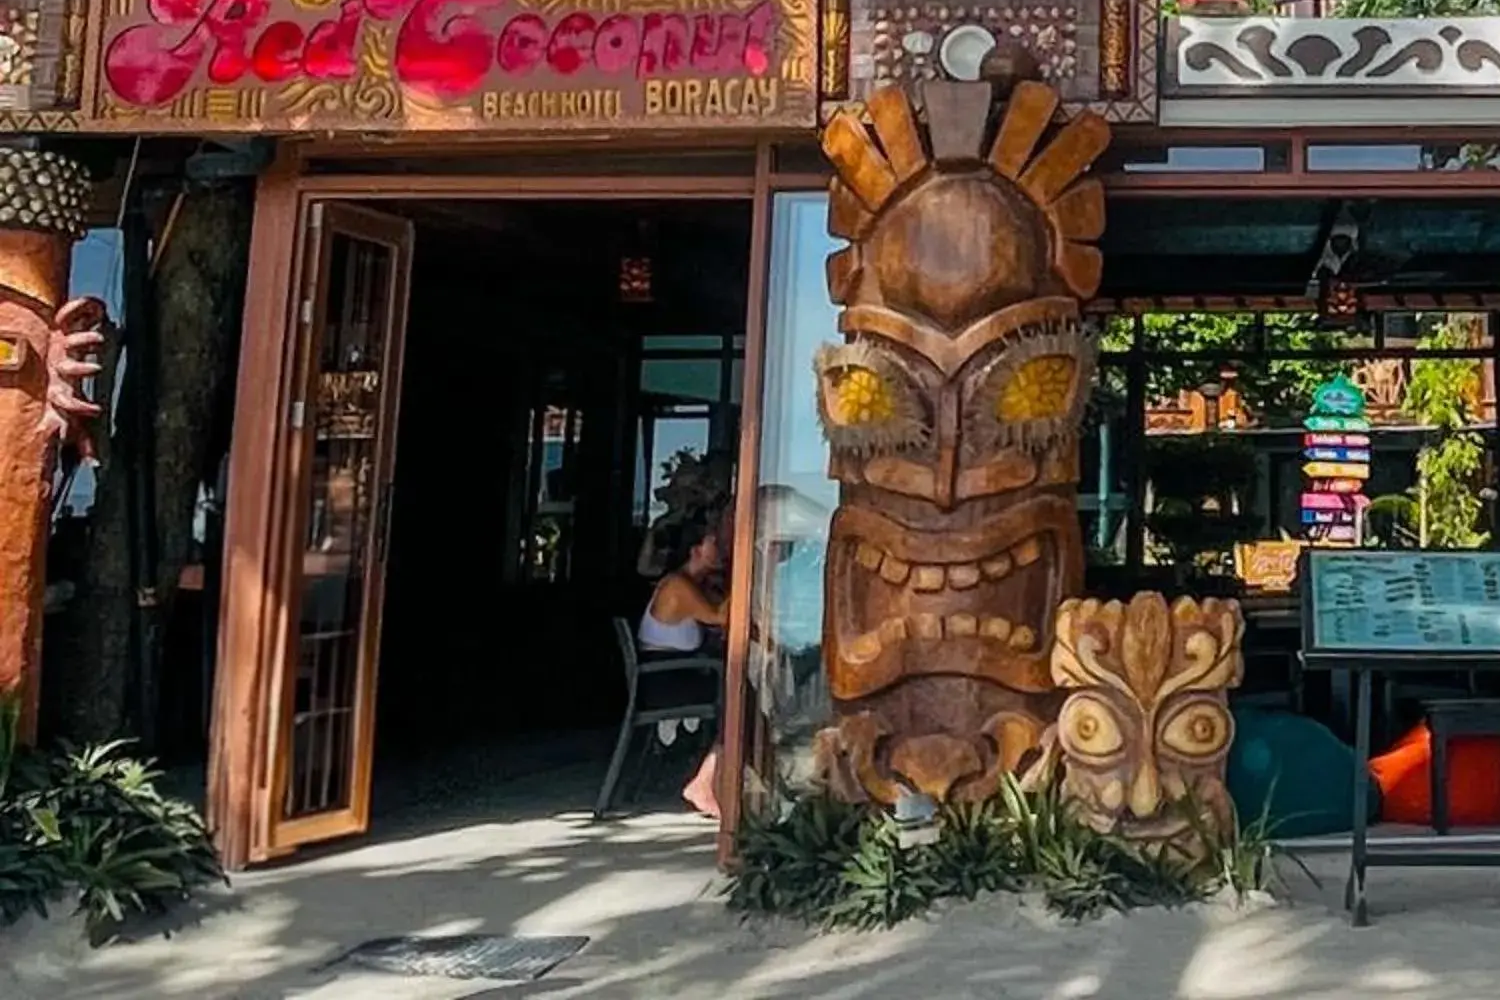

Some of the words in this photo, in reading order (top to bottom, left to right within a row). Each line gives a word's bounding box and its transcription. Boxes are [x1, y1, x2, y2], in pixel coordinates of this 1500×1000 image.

[483, 91, 558, 118] BEACH
[562, 90, 621, 118] HOTEL
[646, 79, 778, 116] BORACAY
